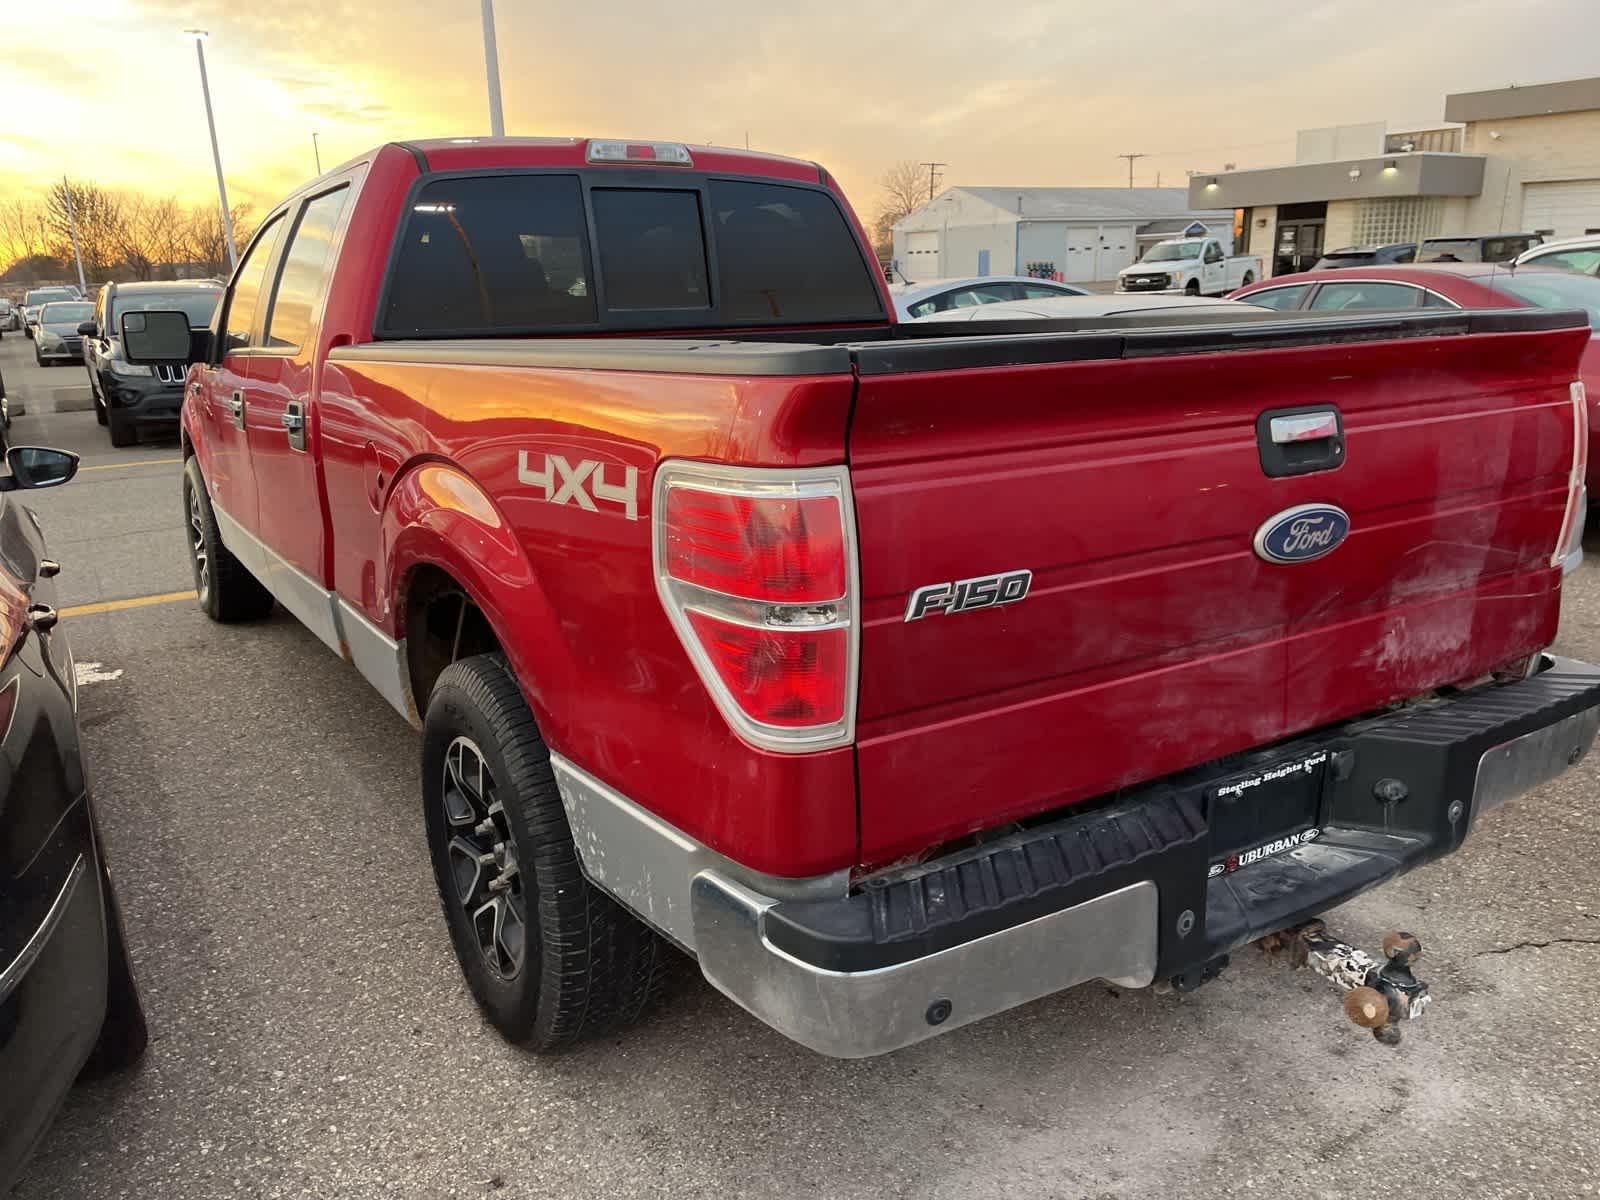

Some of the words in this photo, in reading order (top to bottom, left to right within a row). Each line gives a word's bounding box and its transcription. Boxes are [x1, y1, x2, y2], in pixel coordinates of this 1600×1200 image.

[518, 450, 638, 521] 4X4
[1283, 516, 1335, 553] Ford
[904, 568, 1033, 623] F-150
[1218, 777, 1262, 796] Sterling
[1263, 763, 1302, 782] Heights
[1304, 754, 1327, 768] Ford
